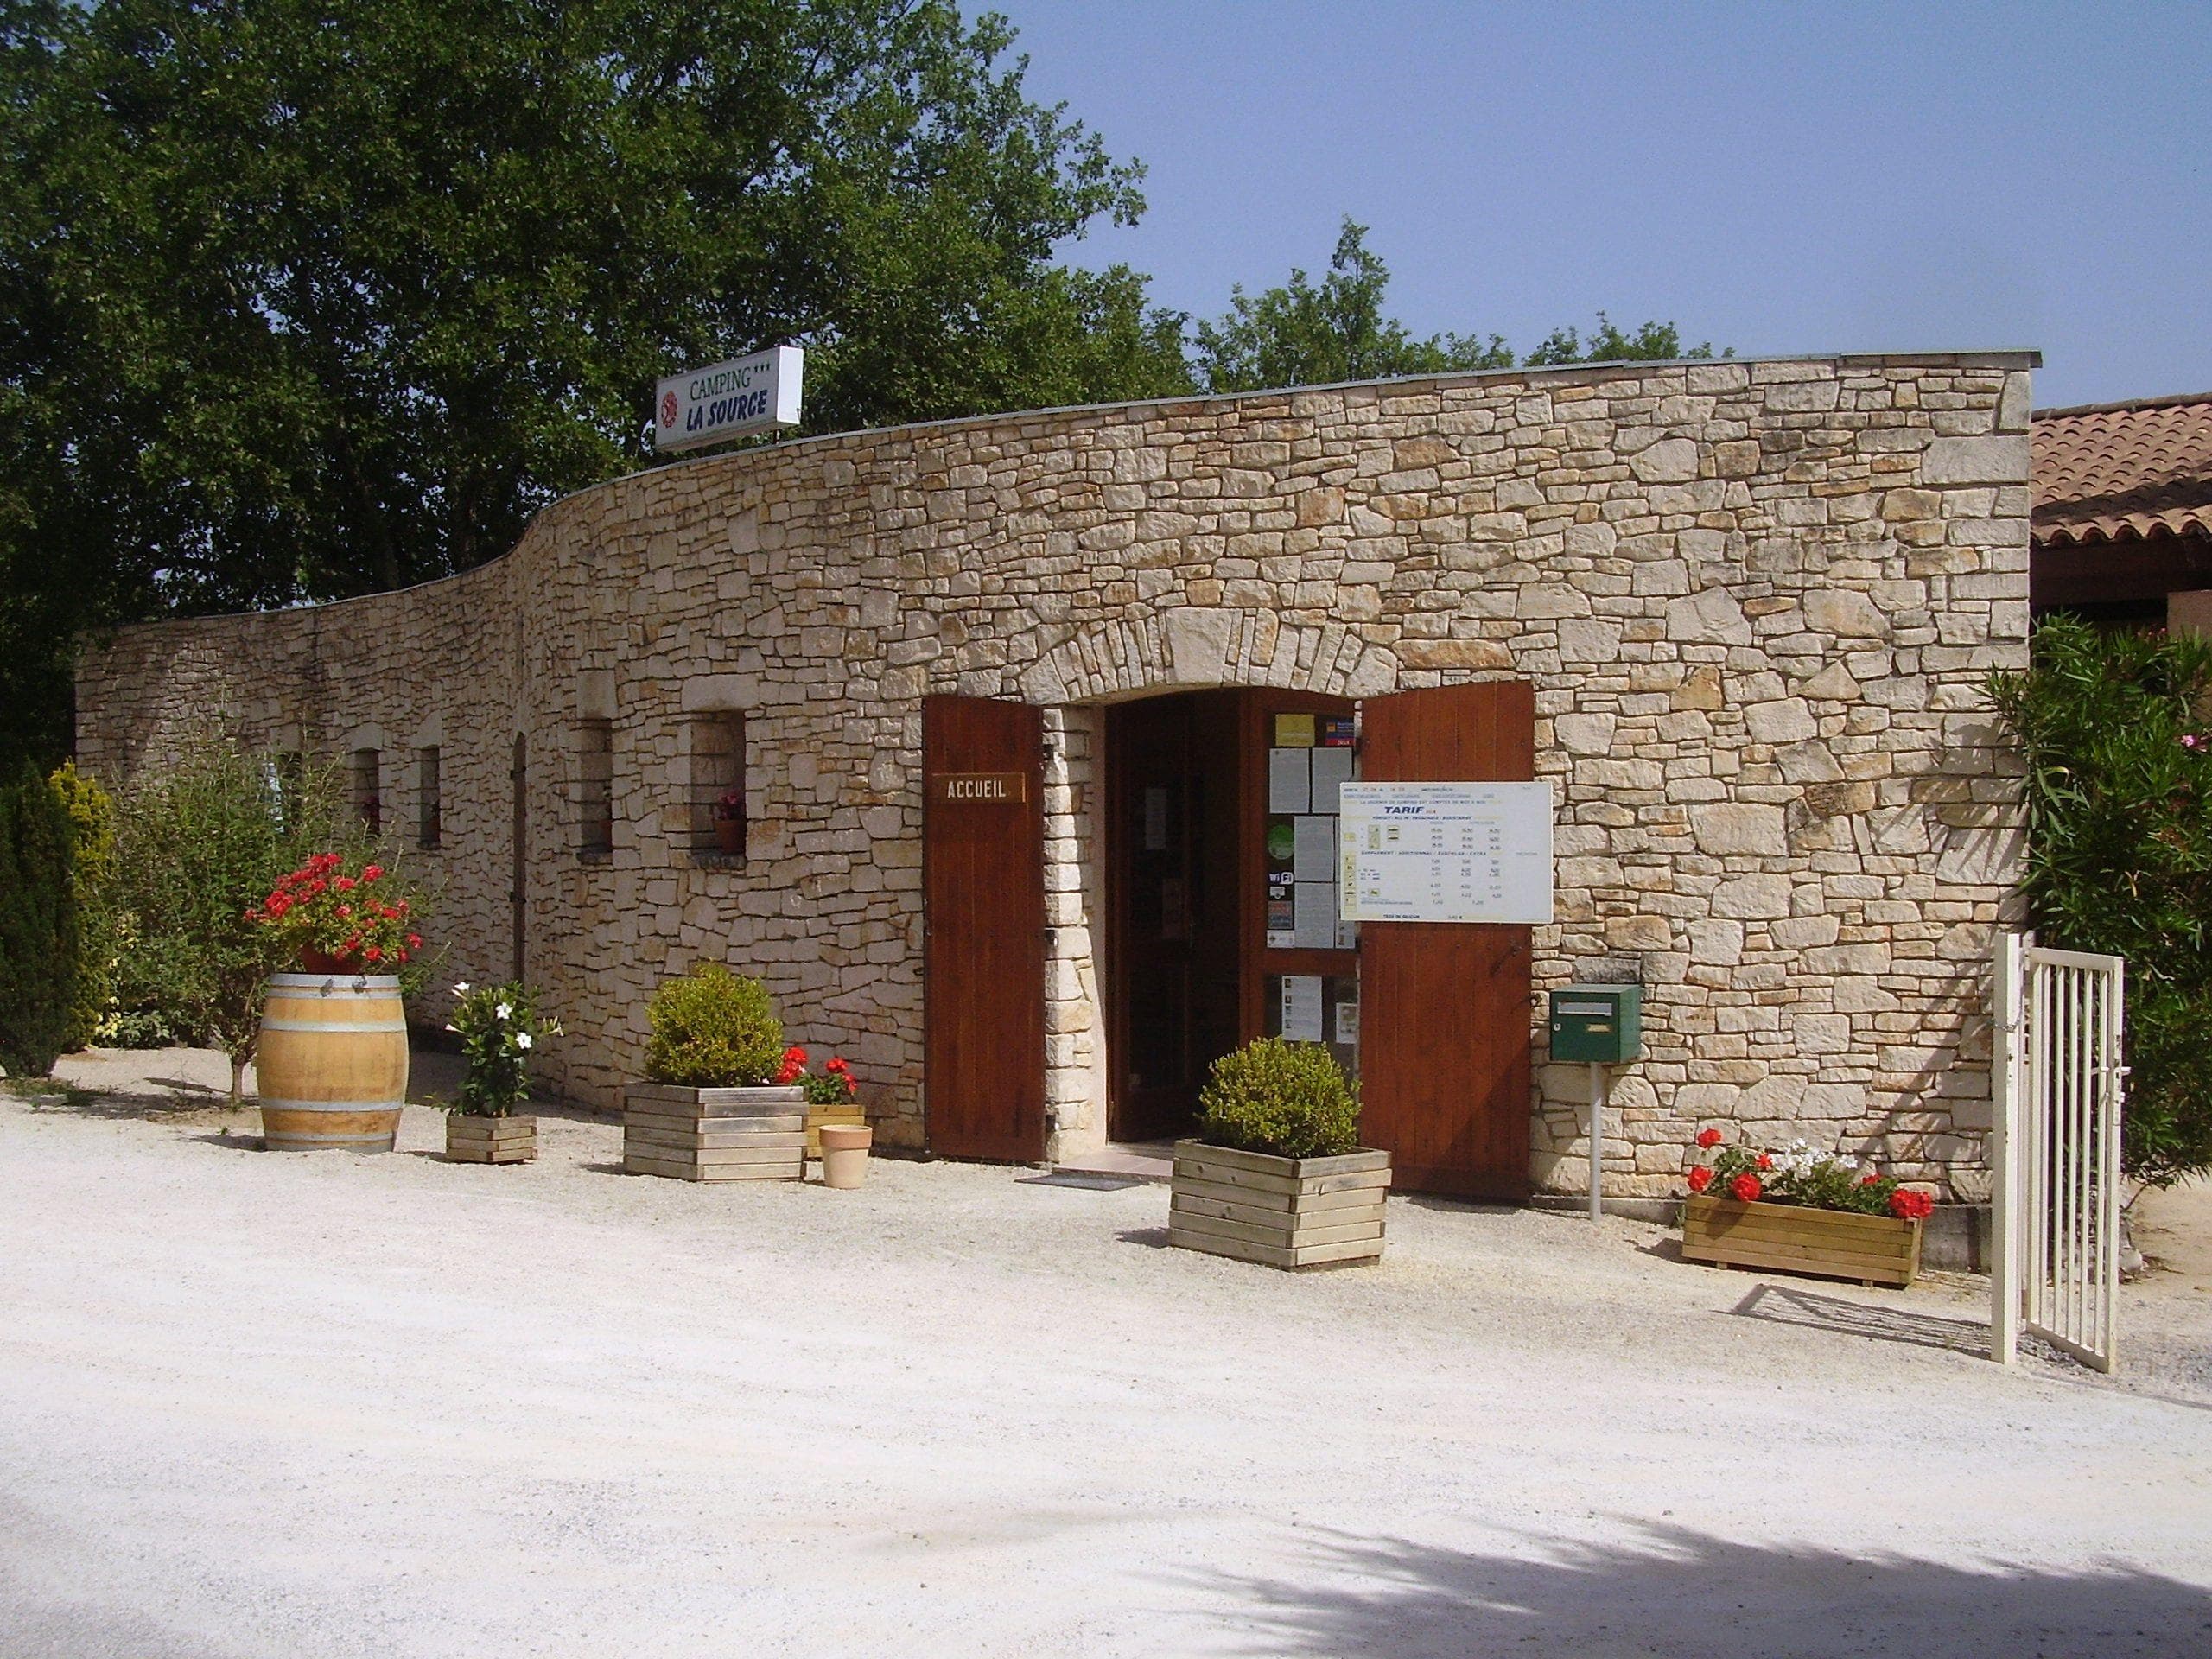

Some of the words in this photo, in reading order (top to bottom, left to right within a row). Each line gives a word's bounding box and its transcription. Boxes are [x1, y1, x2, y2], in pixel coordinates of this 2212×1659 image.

[690, 366, 751, 401] CAMPING
[687, 405, 703, 431] LA
[708, 389, 767, 427] SOURCE
[947, 779, 1007, 798] ACCUEIL
